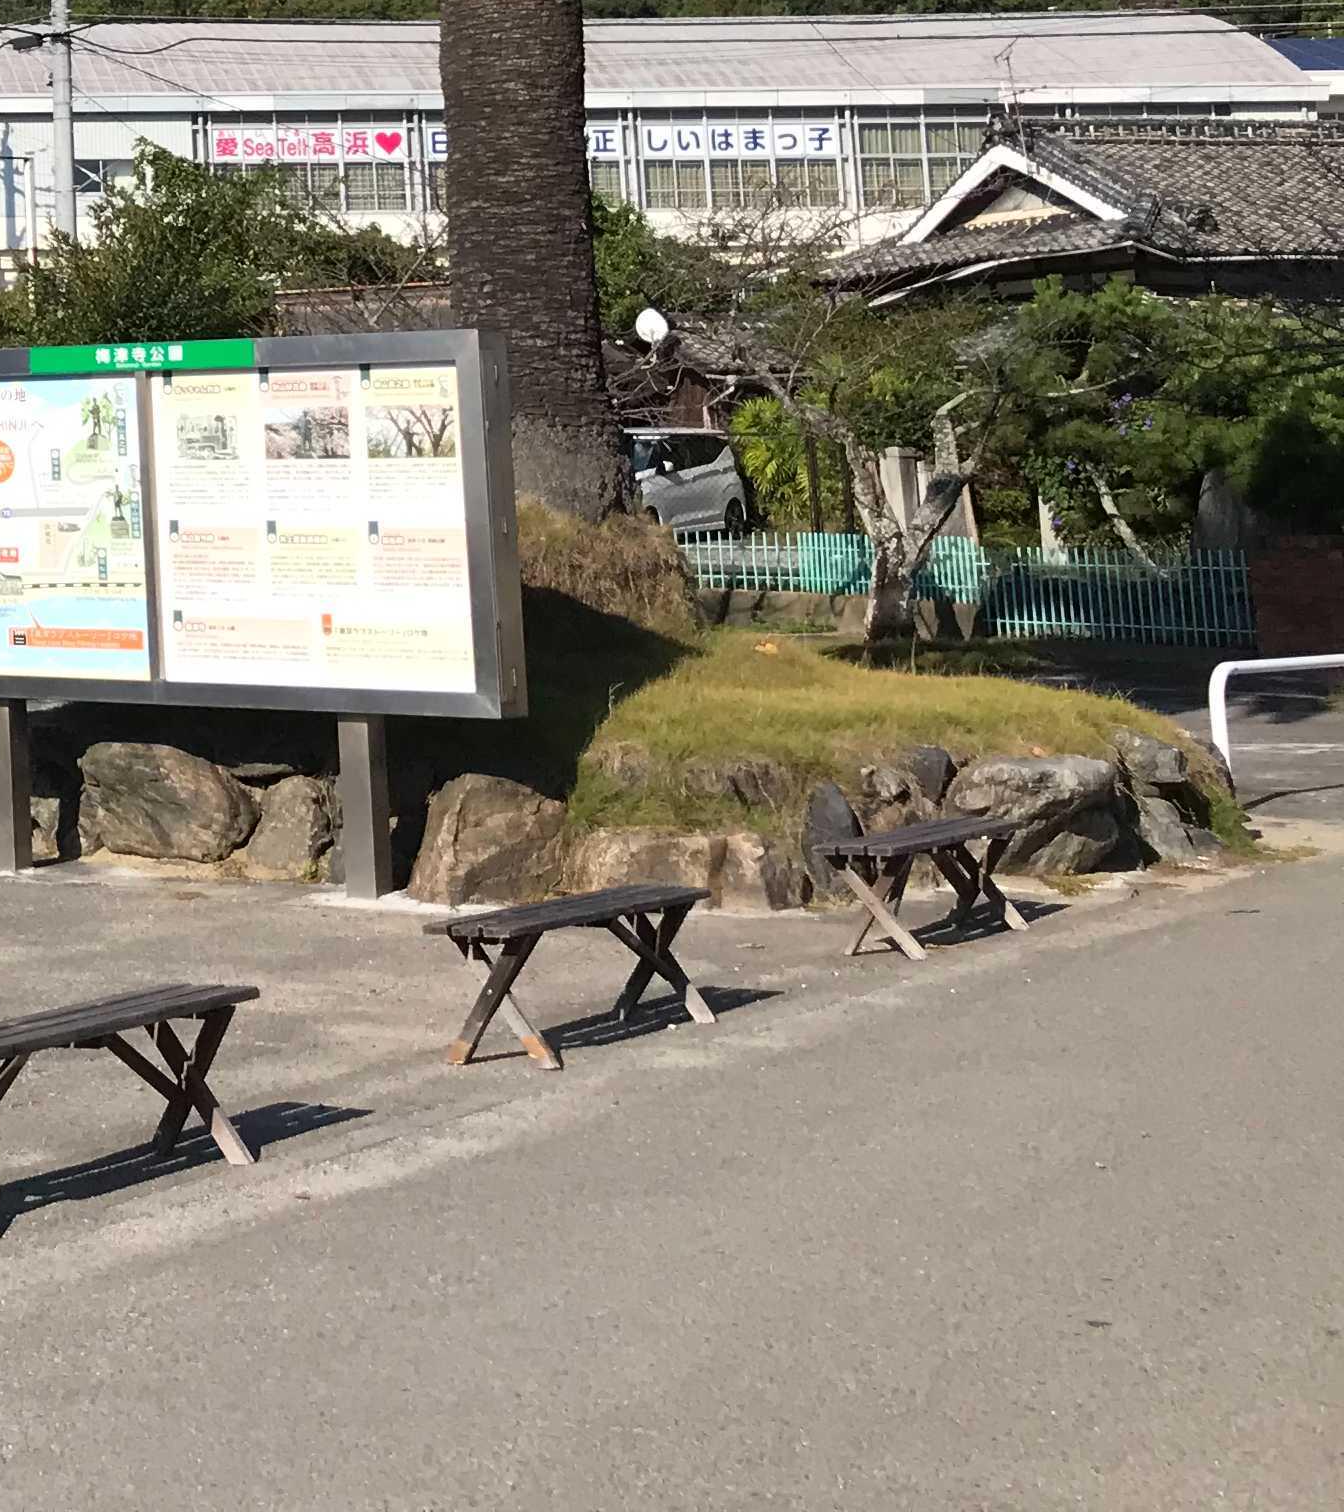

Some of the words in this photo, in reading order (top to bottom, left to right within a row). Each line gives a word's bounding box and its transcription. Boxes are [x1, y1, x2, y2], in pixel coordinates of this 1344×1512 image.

[95, 345, 183, 364] 梅津寺公園
